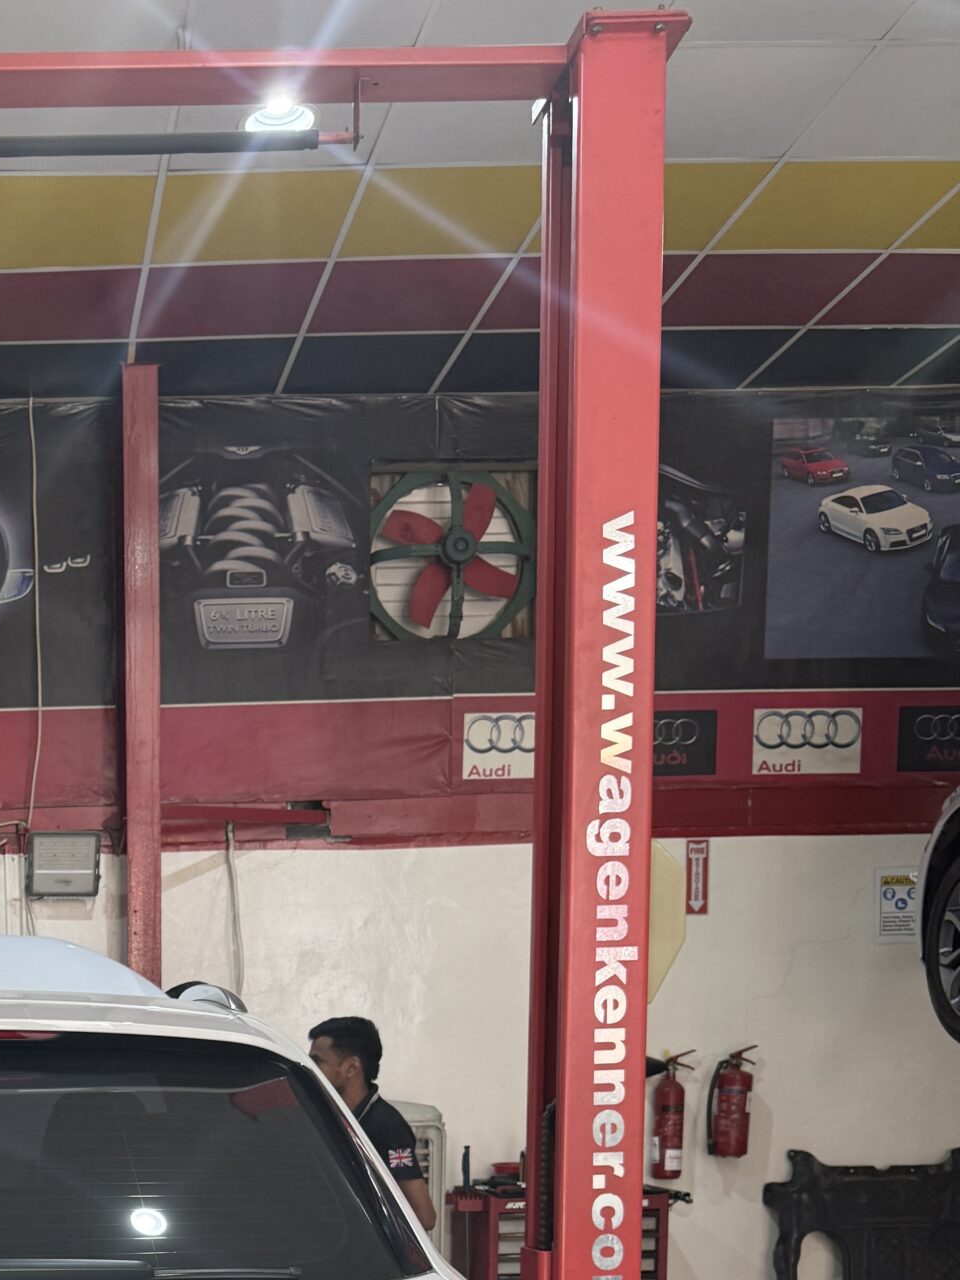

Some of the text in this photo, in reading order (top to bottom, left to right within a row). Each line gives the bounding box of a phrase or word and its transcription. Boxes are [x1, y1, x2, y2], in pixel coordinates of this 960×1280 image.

[236, 608, 277, 621] LITRE
[208, 623, 280, 633] TWIN TURBO
[653, 749, 688, 765] udi
[467, 764, 511, 778] Audi
[757, 760, 801, 773] Audi
